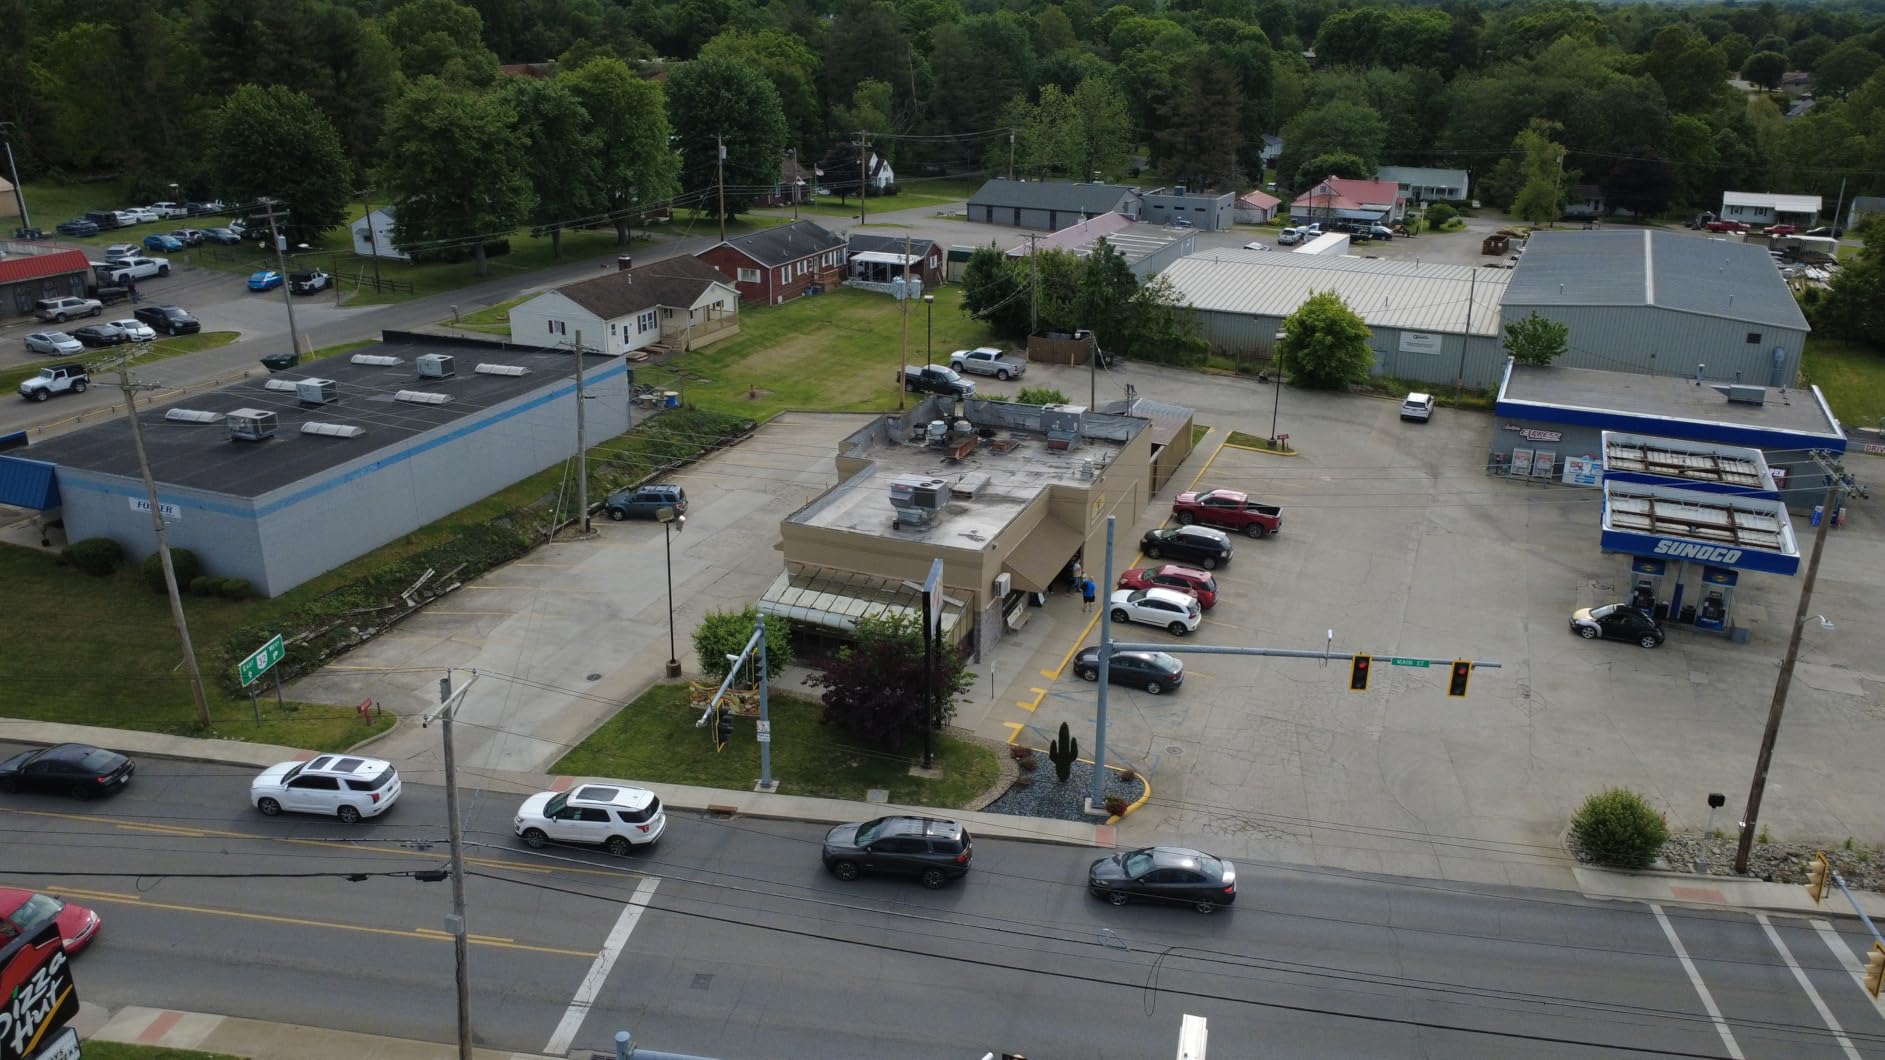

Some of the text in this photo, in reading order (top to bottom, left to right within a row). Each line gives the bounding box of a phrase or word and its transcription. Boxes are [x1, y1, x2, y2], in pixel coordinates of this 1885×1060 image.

[138, 501, 173, 514] FOER
[1653, 540, 1743, 564] SUNOCO
[10, 975, 64, 1055] Hut
